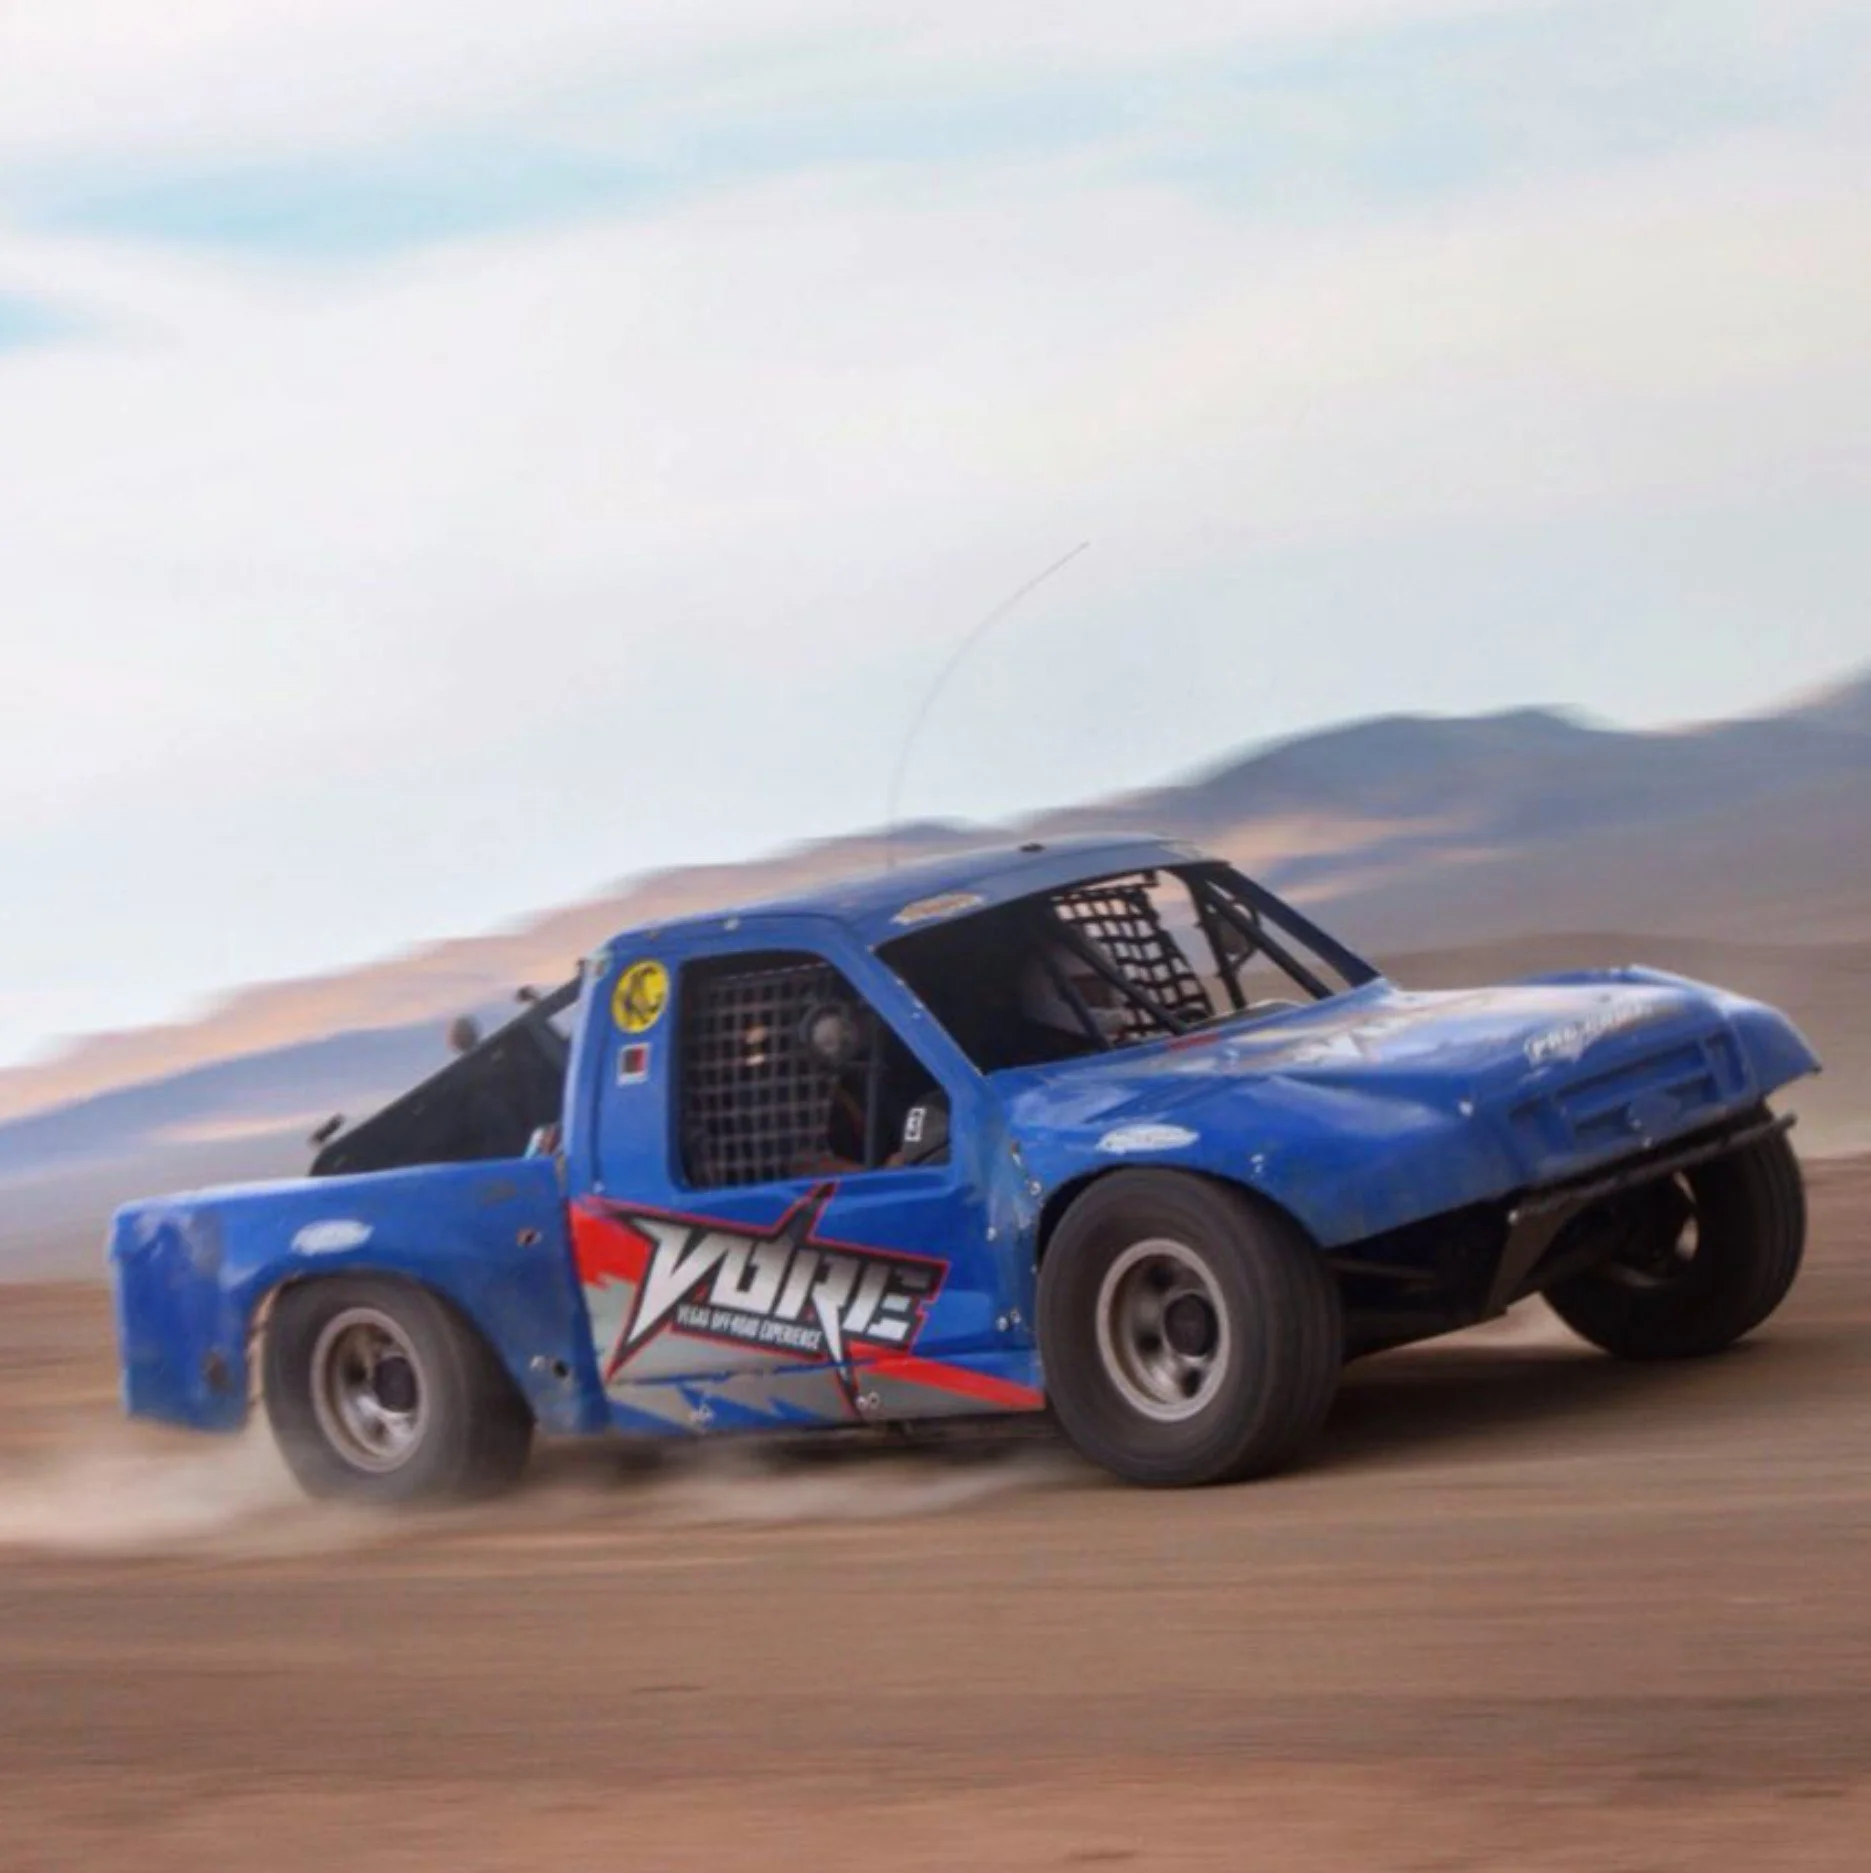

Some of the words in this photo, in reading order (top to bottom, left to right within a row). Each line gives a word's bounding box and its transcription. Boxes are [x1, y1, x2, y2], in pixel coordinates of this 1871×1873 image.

[631, 1214, 933, 1366] VORE
[676, 1303, 711, 1328] VEGAS
[758, 1318, 822, 1351] EXPERIENCE
